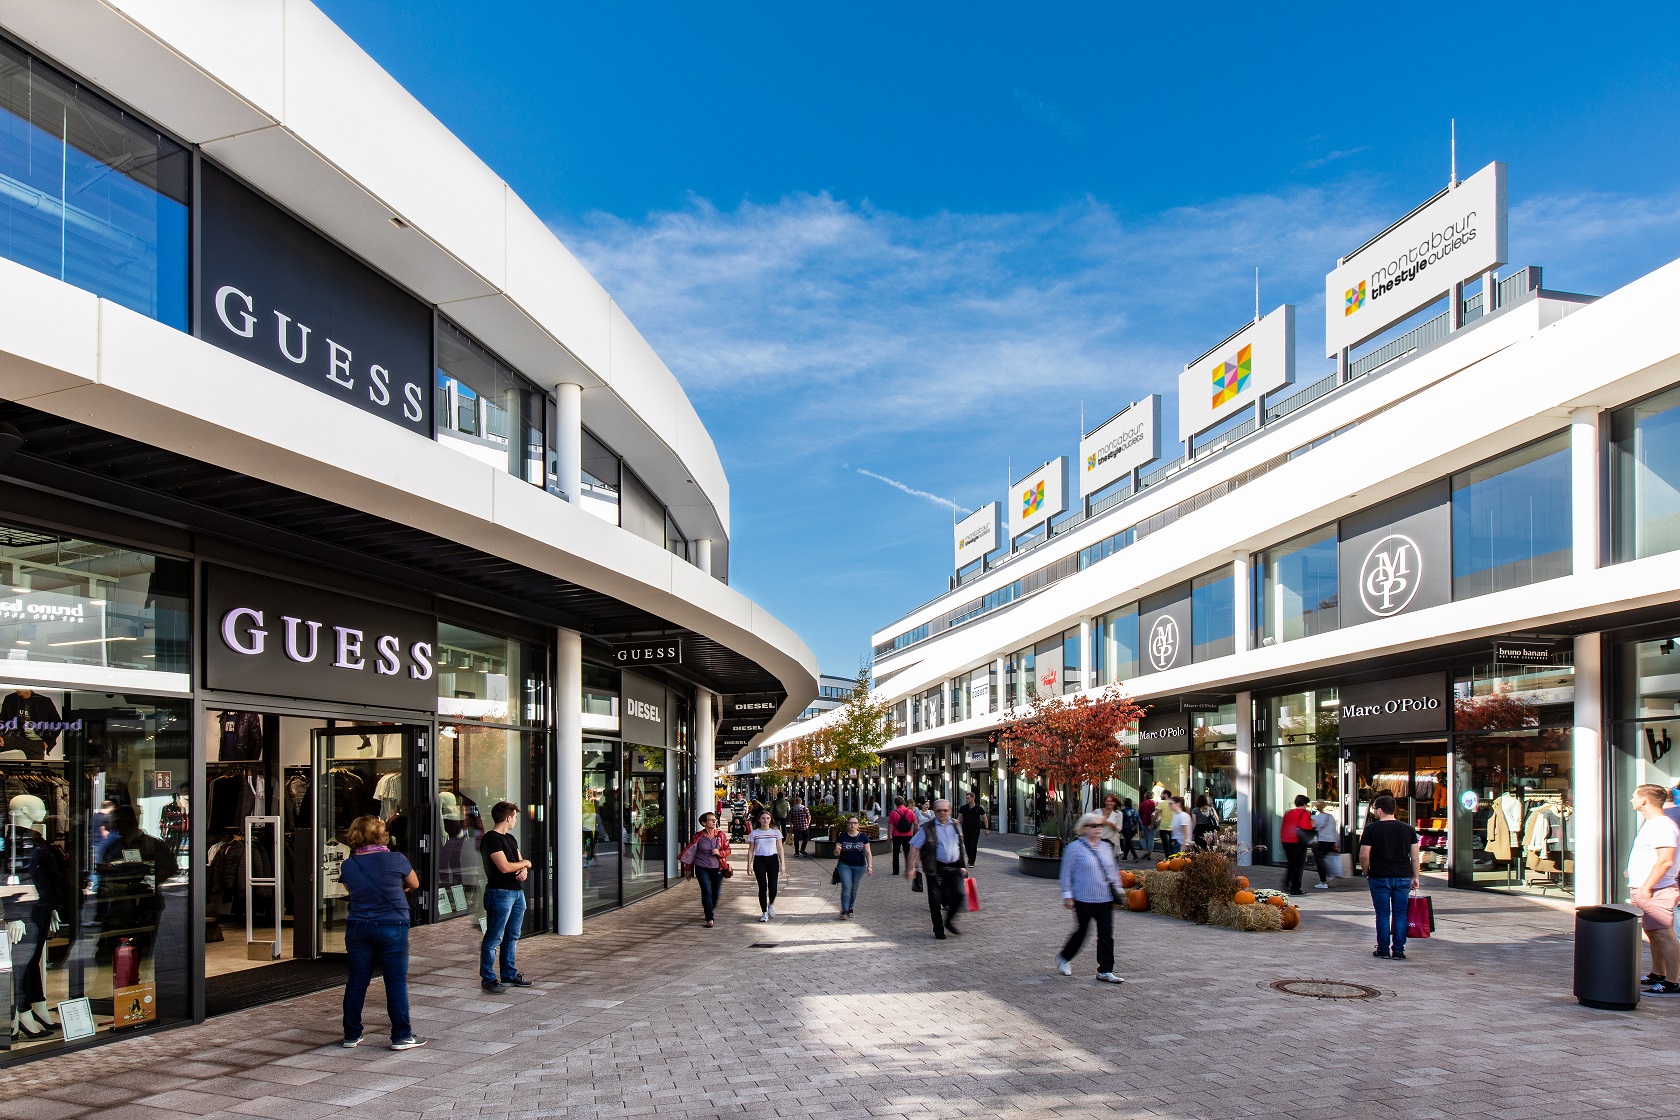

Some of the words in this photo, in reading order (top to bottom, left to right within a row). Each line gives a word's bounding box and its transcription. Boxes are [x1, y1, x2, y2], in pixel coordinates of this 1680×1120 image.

[1371, 211, 1477, 287] montabaur
[215, 285, 423, 422] GUESS
[219, 607, 433, 681] GUESS
[617, 647, 676, 661] GUESS
[1499, 647, 1522, 656] bruno
[1522, 648, 1548, 657] banani
[627, 697, 661, 723] DIESEL
[735, 702, 776, 710] DIESEL
[1342, 704, 1381, 719] Marc
[1384, 696, 1438, 714] O'Polo
[1139, 730, 1159, 740] Marc
[1159, 726, 1185, 738] O'Polo
